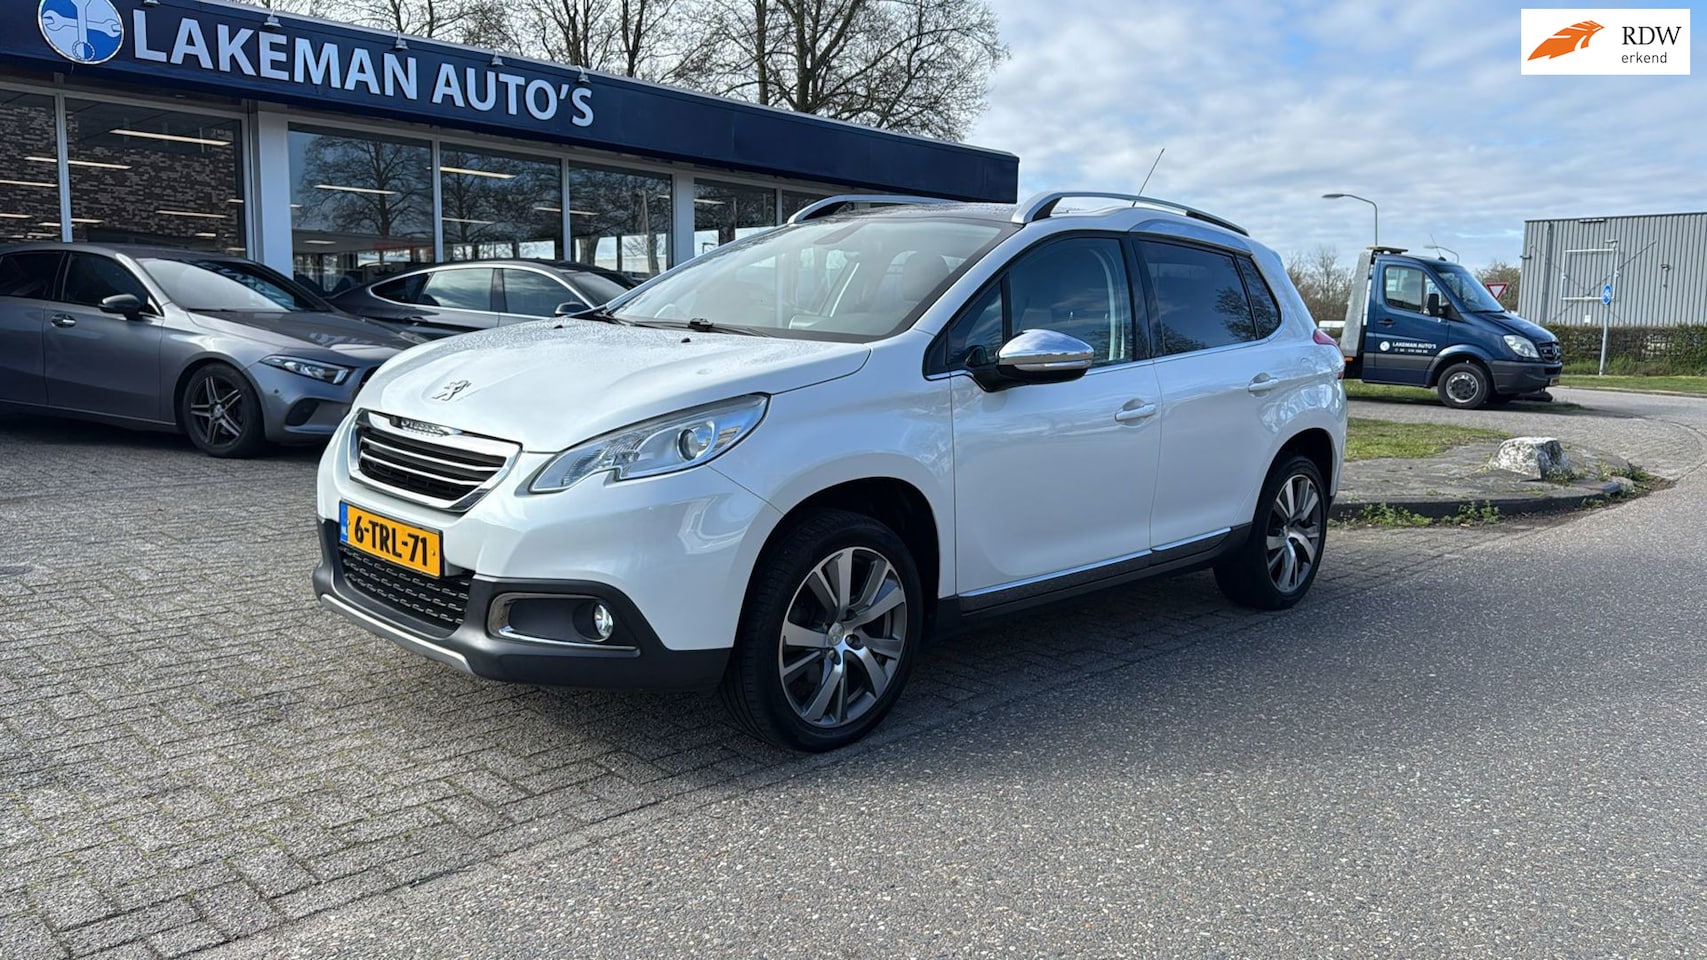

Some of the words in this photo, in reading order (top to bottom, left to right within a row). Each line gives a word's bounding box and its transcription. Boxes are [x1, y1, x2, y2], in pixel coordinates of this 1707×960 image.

[132, 9, 418, 100] LAKEMAN
[431, 63, 595, 128] AUTO'S
[354, 515, 428, 567] 6-TRL-71
